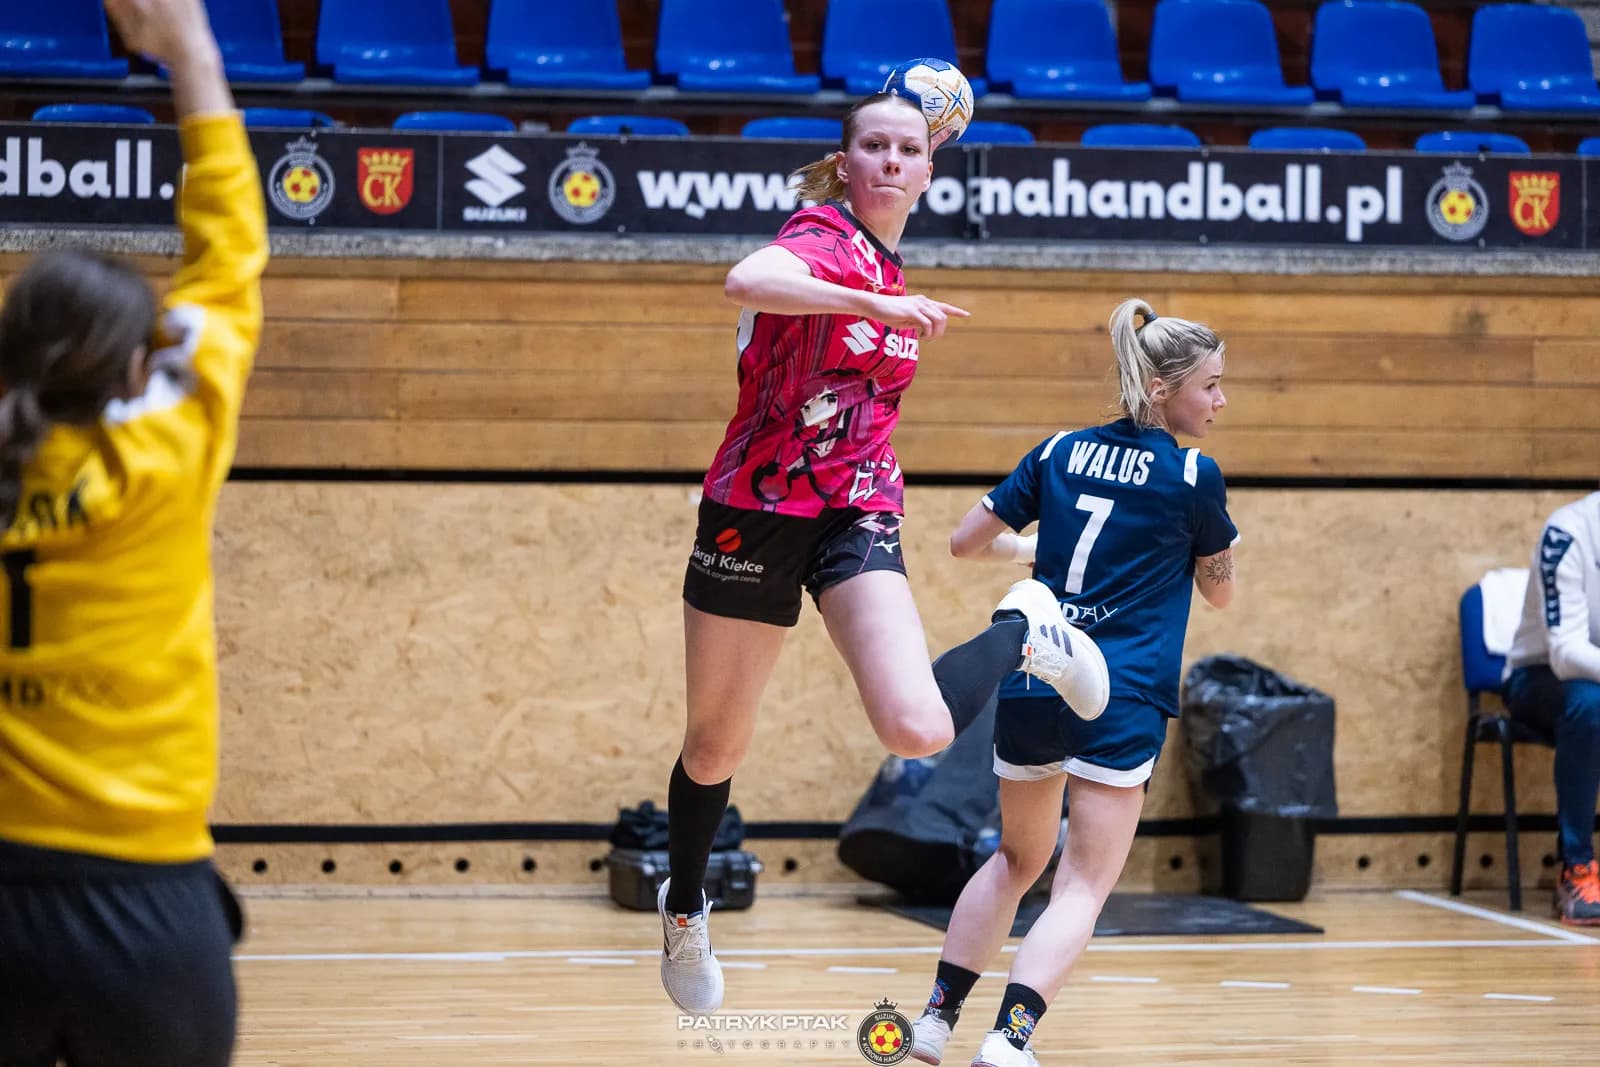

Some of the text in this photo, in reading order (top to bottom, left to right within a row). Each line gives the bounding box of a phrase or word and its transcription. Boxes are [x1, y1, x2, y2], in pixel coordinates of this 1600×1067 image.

[363, 174, 402, 207] CK
[463, 206, 528, 222] SUZUKI
[1513, 197, 1551, 230] CK
[1066, 440, 1155, 486] WALUS
[1065, 493, 1115, 595] 7
[719, 555, 764, 573] Kielce
